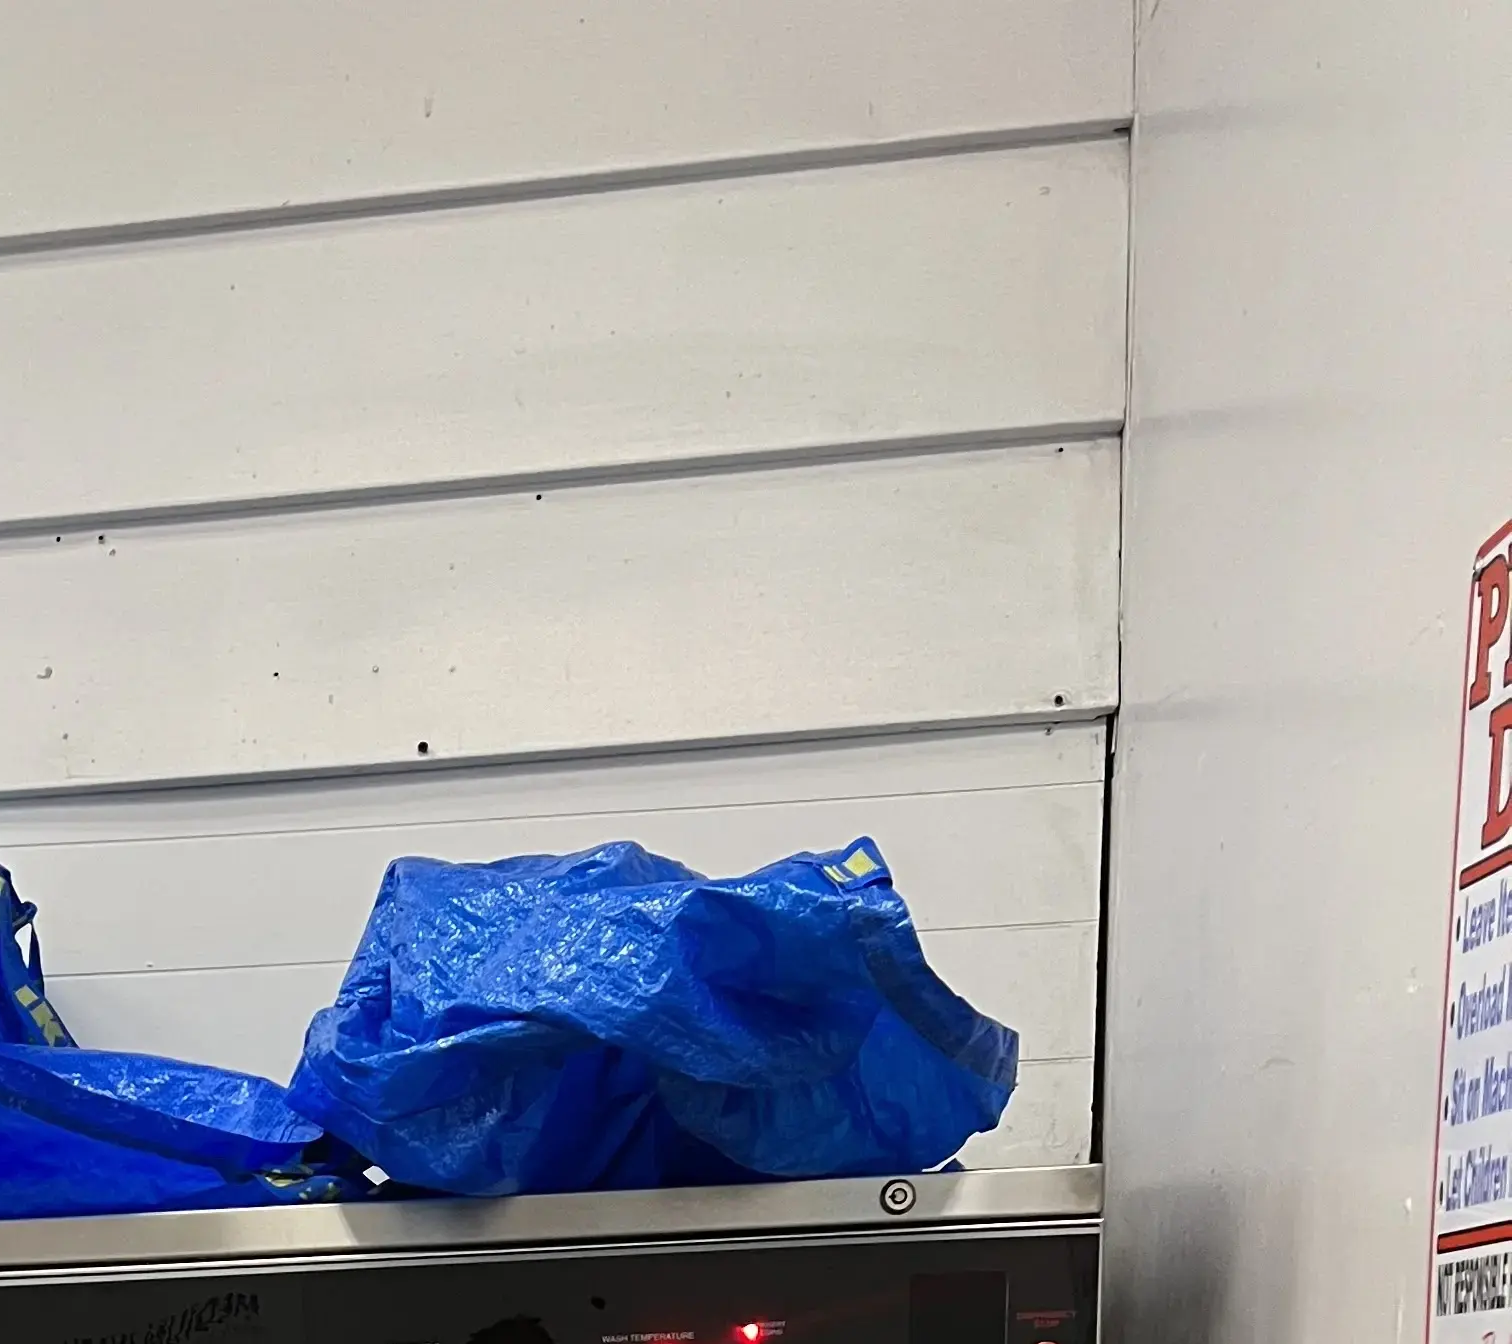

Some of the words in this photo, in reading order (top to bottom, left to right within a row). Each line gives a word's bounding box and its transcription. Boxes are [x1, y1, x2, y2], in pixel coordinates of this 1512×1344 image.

[1462, 895, 1495, 953] Leave
[1457, 964, 1506, 1040] Overload
[1465, 1144, 1508, 1207] Children
[602, 1335, 628, 1343] WASH
[630, 1332, 695, 1341] TEMPERATURE
